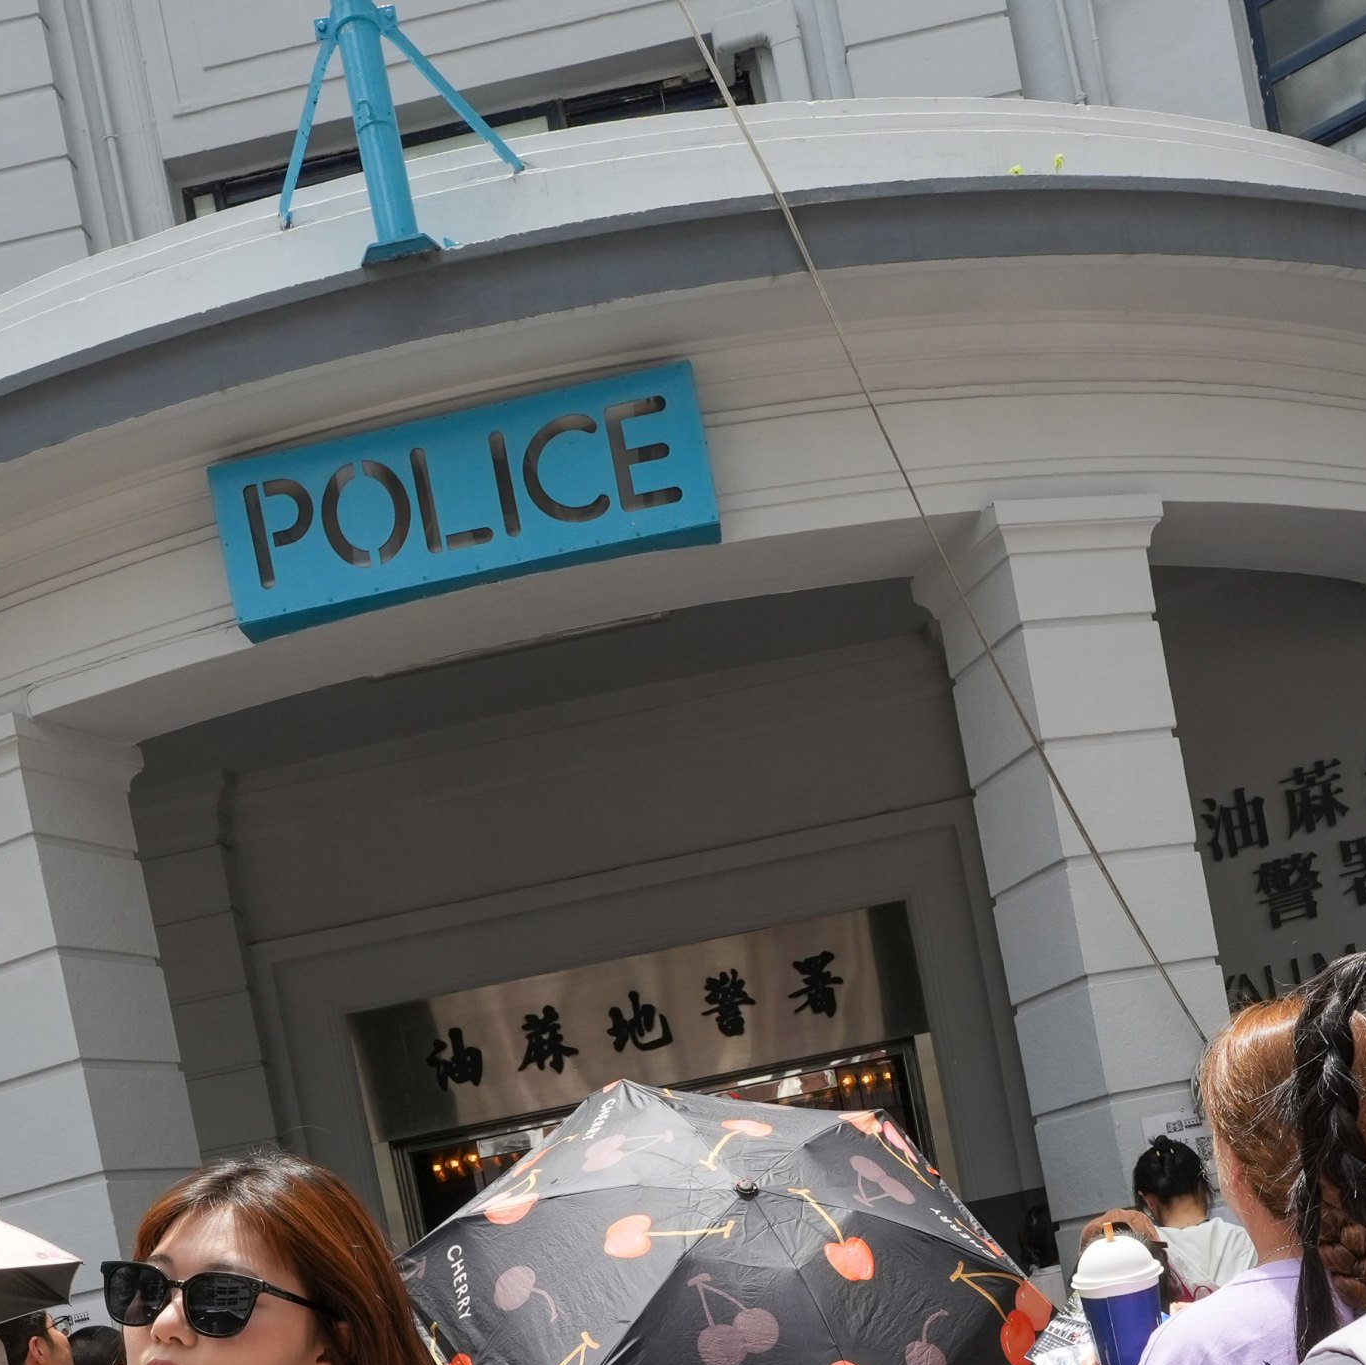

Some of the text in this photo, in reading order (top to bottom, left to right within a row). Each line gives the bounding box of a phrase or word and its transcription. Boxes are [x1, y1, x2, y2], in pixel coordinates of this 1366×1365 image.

[242, 395, 684, 590] POLICE
[427, 951, 843, 1092] 油蔴地警署
[581, 1097, 618, 1141] CHERRY
[929, 1207, 997, 1259] CHERRY
[446, 1244, 473, 1320] CHERRY
